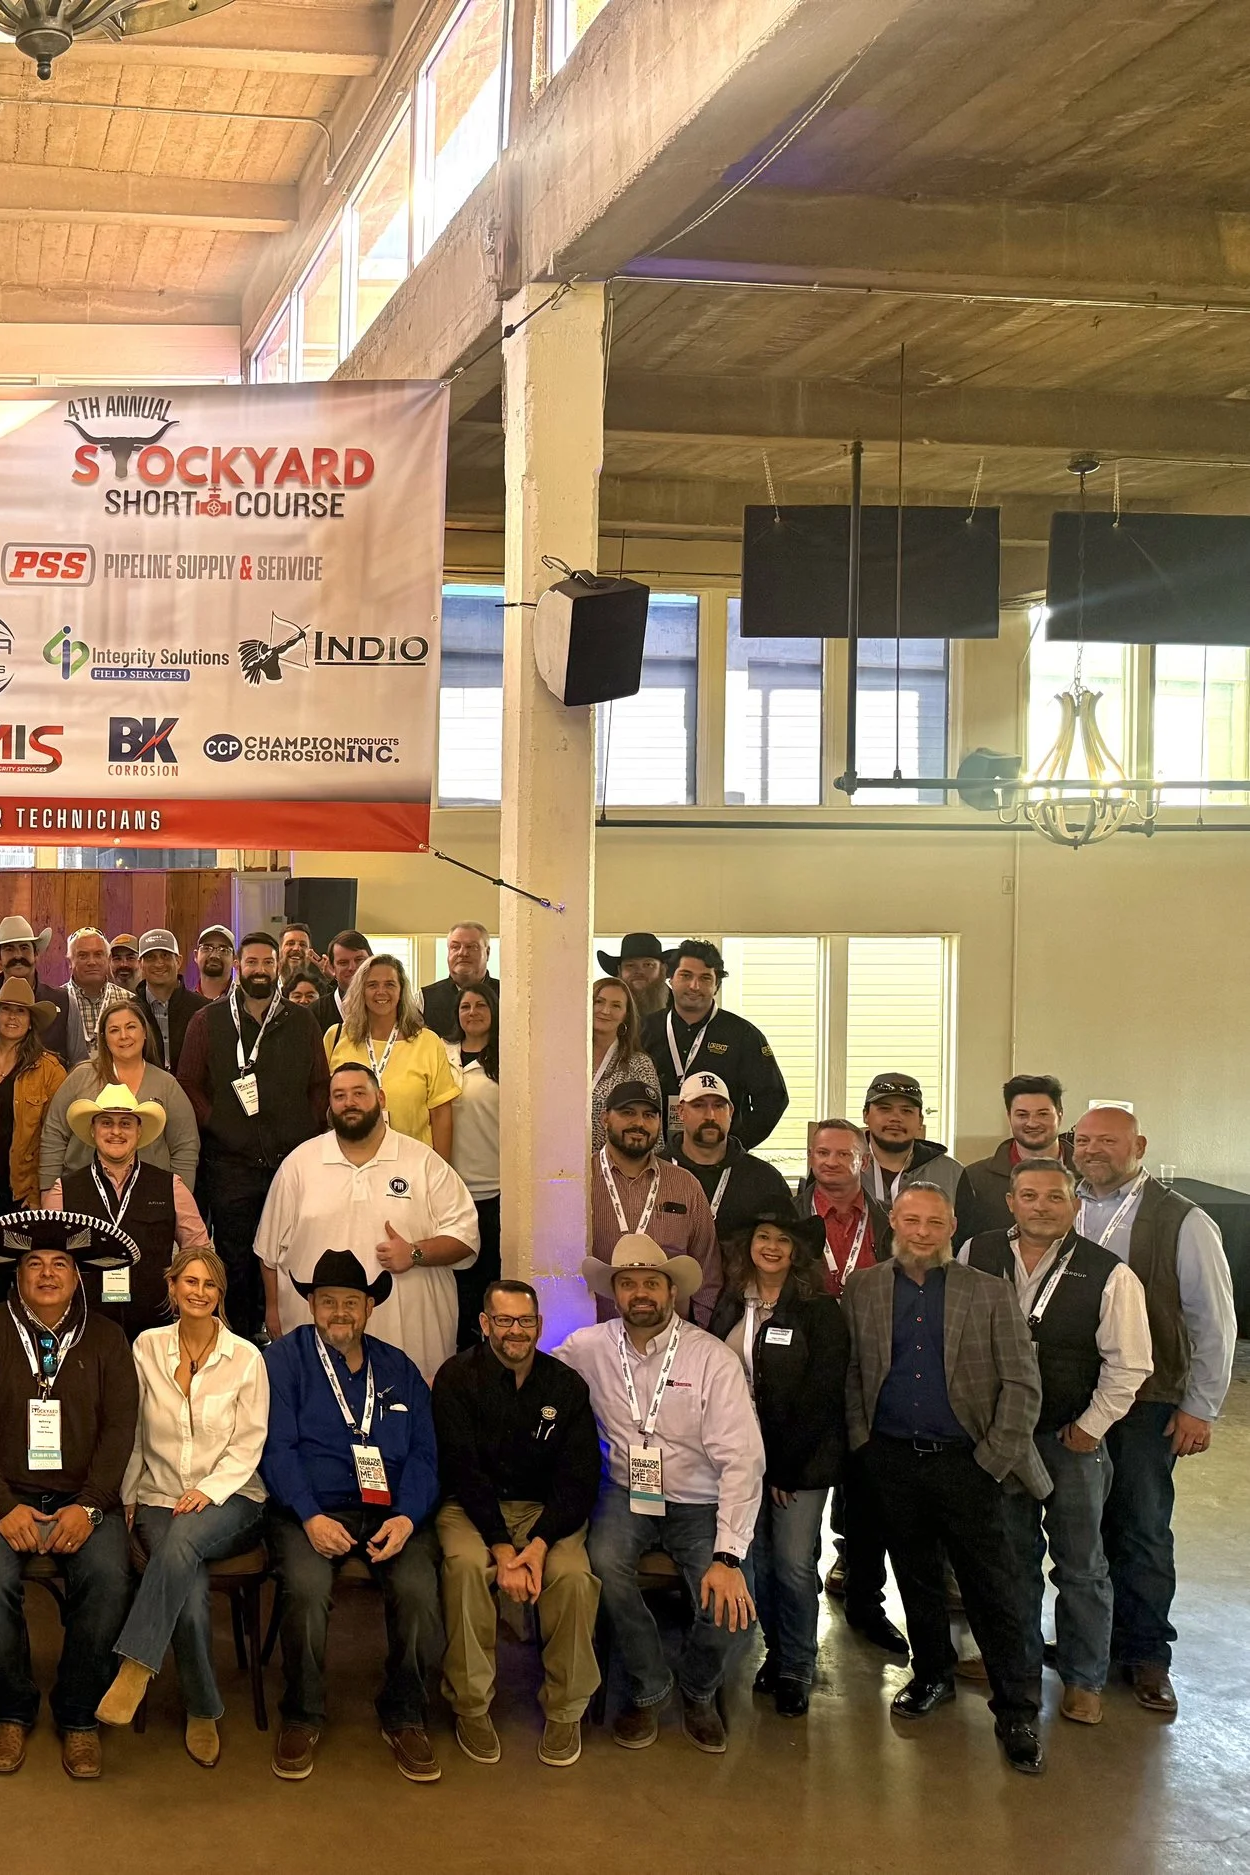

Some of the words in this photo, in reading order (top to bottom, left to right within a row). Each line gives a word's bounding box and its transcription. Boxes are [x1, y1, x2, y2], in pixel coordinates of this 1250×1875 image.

[67, 396, 101, 422] 4TH
[105, 394, 173, 422] ANNUAL
[104, 488, 197, 518] SHORT
[235, 491, 346, 519] COURSE
[7, 550, 88, 580] PSS
[103, 553, 172, 580] PIPELINE
[176, 554, 235, 581] SUPPLY
[239, 555, 254, 581] &
[256, 555, 324, 582] SERVICE
[313, 631, 429, 662] INDIO
[92, 647, 155, 668] Integrity
[160, 648, 230, 666] Solutions
[93, 670, 127, 679] FIELD
[129, 670, 182, 680] SERVICES
[107, 716, 180, 763] BK
[205, 740, 239, 756] CCP
[244, 736, 346, 750] CHAMPION
[346, 737, 400, 746] PRODUCTS
[244, 749, 346, 762] CORROSION
[345, 745, 400, 763] INC.
[107, 764, 180, 777] CORROSION
[15, 807, 162, 831] TECHNICIANS
[360, 1471, 373, 1479] ME
[632, 1472, 646, 1482] ME
